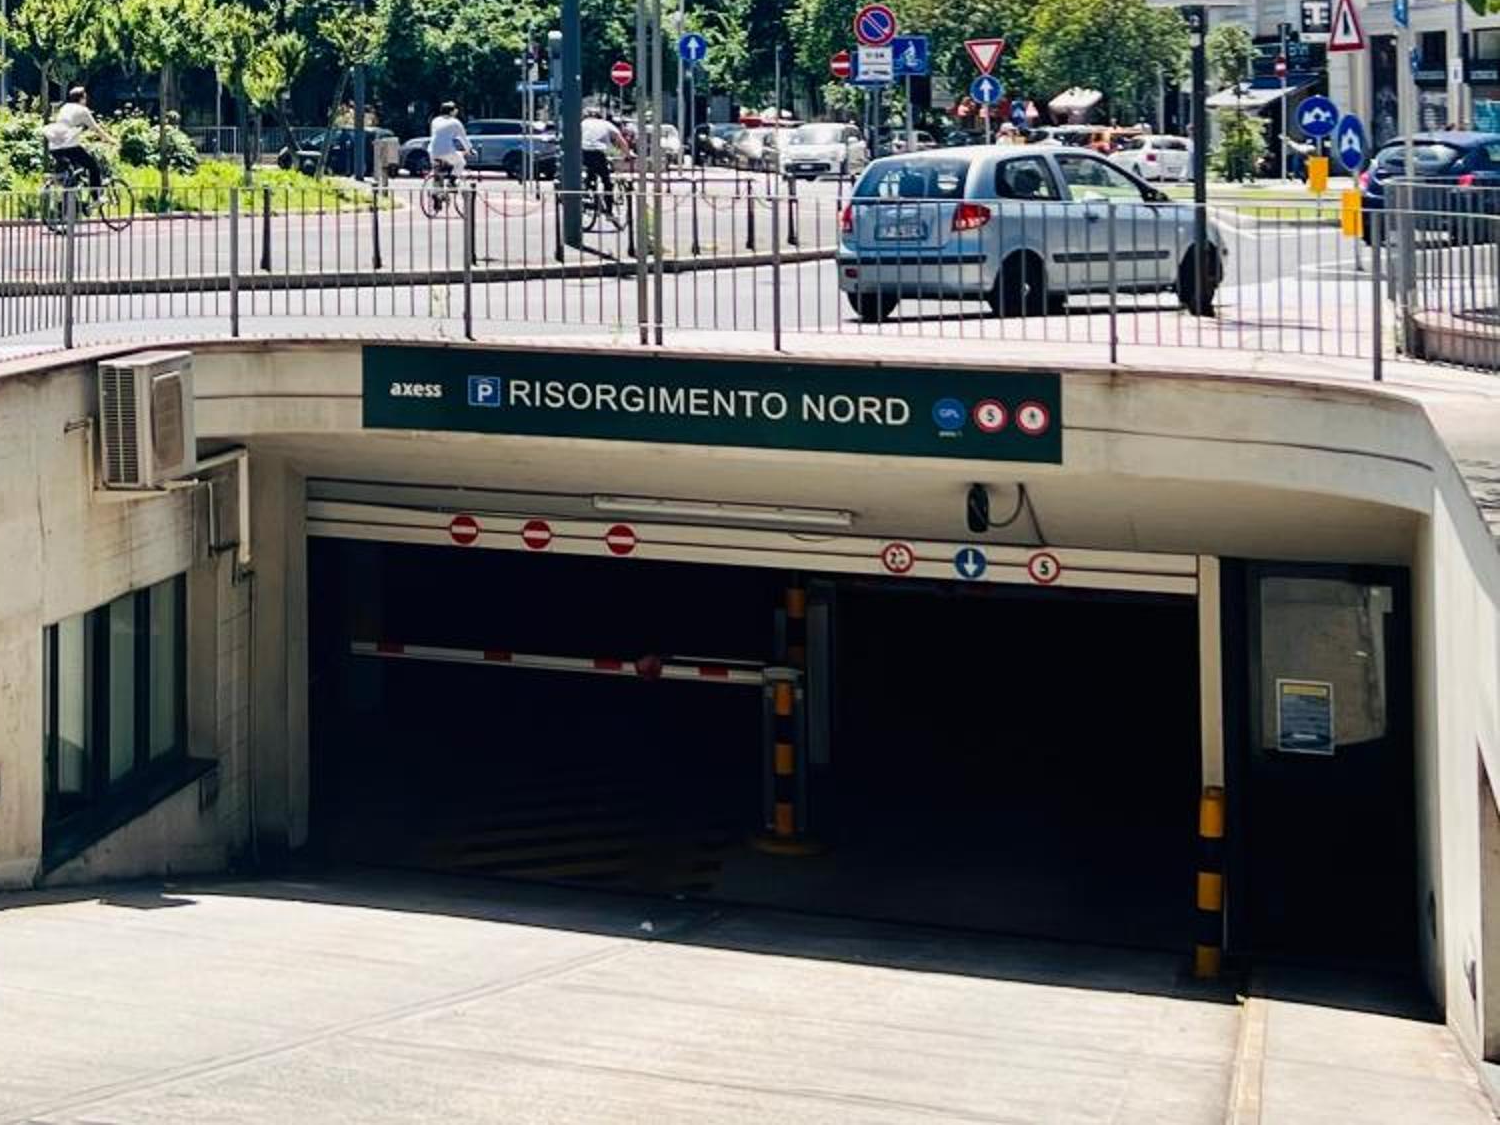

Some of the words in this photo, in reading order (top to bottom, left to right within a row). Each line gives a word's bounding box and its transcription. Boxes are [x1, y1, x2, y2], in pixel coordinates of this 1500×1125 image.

[390, 382, 442, 398] axess
[477, 384, 493, 402] P
[509, 379, 788, 420] RISORGIMENTO
[802, 393, 910, 425] NORD
